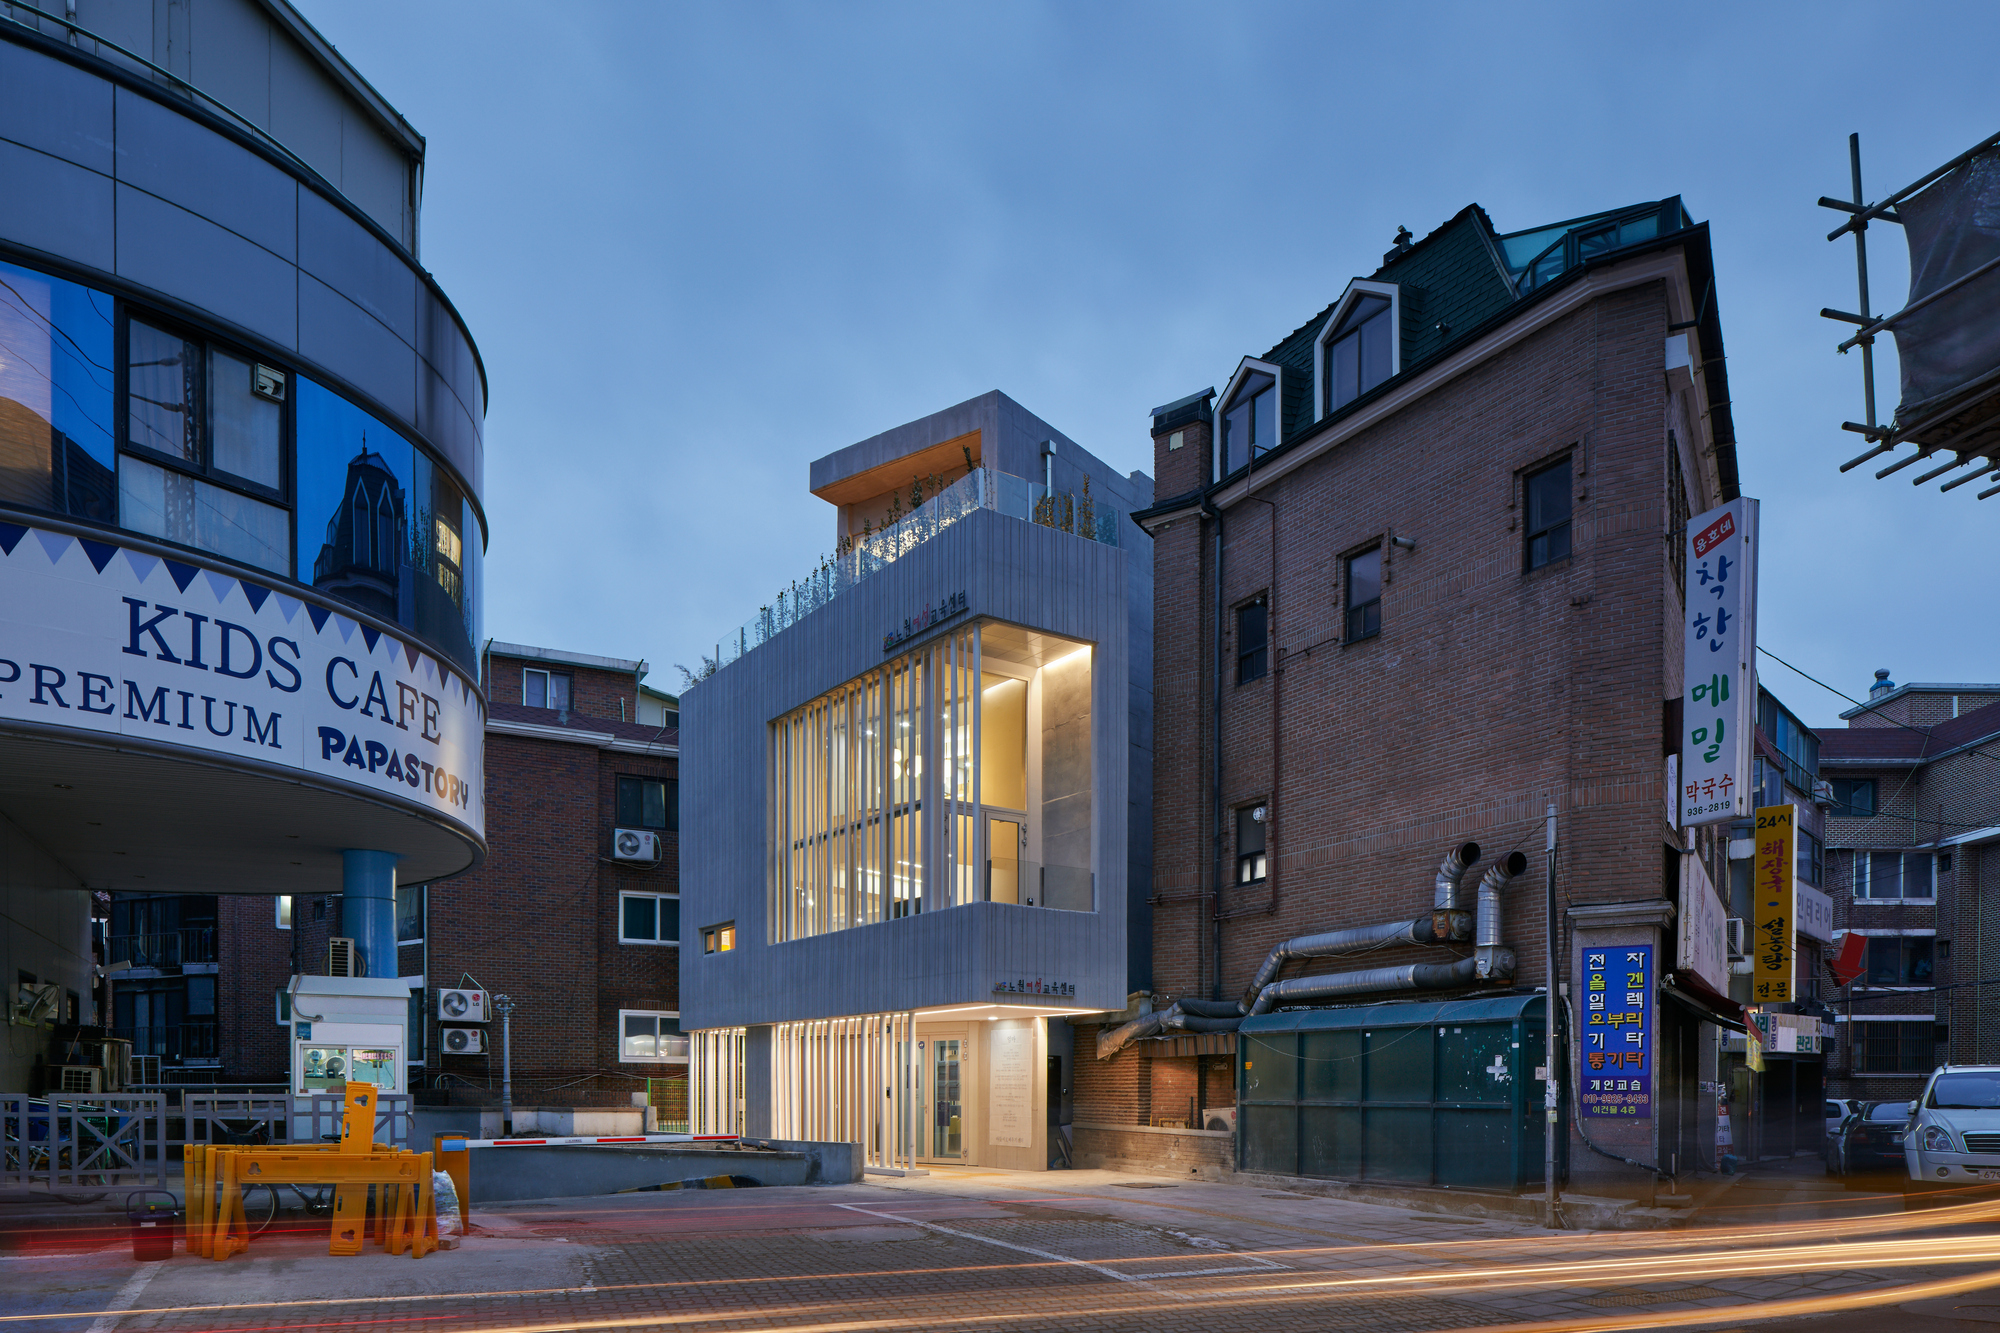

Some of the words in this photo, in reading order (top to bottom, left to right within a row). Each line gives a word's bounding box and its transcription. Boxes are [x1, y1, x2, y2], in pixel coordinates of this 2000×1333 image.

[121, 595, 303, 693] KIDS
[325, 656, 443, 746] CAFE
[317, 725, 469, 810] PAPASTORY
[1685, 773, 1735, 804] 막국수
[1686, 800, 1731, 817] 936-2819
[1757, 812, 1792, 829] 24시
[1588, 1011, 1643, 1029] 오부리
[1796, 1035, 1813, 1052] 관리
[1588, 1051, 1645, 1070] 통기타
[1582, 1093, 1649, 1104] 010-9925-9433
